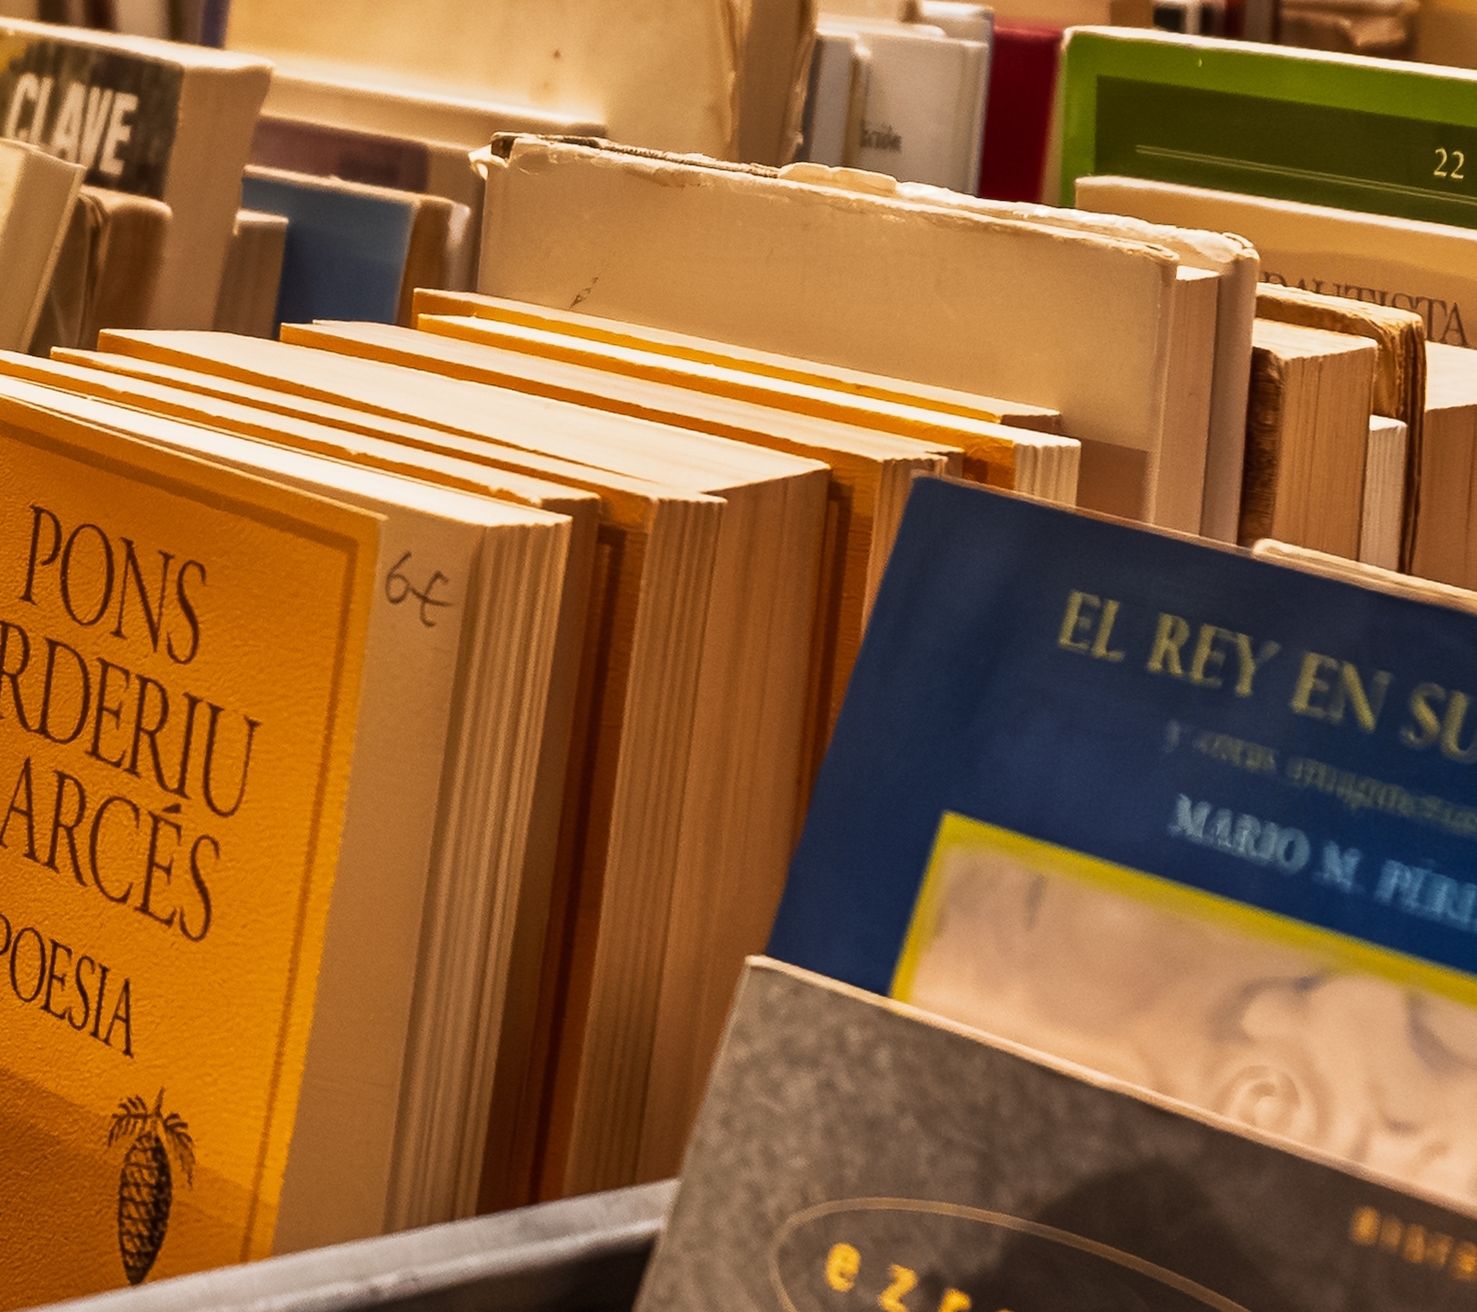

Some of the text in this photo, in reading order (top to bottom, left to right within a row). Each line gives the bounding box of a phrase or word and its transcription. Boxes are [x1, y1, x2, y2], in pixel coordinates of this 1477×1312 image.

[1431, 146, 1468, 183] 22
[19, 503, 208, 665] PONS
[1057, 588, 1127, 665] EL
[1147, 611, 1279, 699] REY
[1290, 650, 1393, 736] EN
[1168, 793, 1312, 875] MARIO
